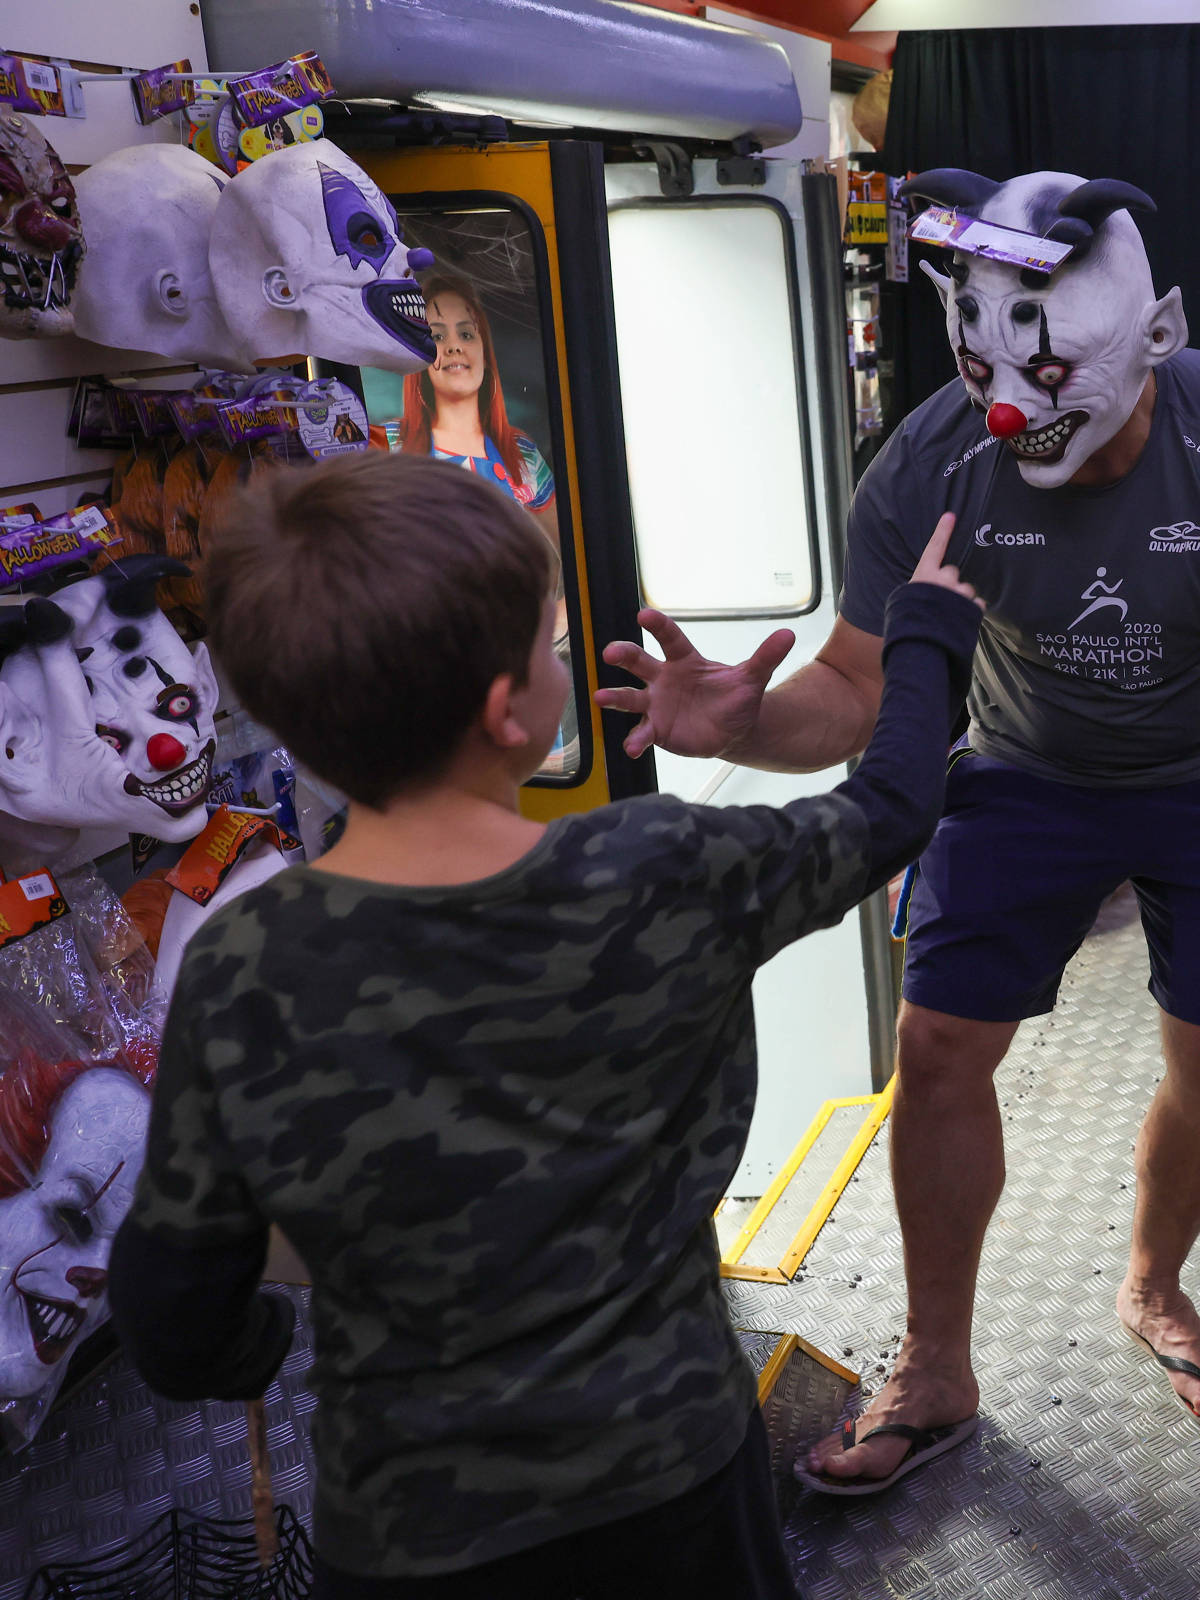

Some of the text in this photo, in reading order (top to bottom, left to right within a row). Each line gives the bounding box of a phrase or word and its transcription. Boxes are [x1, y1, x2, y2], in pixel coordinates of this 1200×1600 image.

[225, 404, 280, 435] HALLOWEEN
[994, 532, 1046, 546] cosan
[1124, 623, 1162, 634] 2020
[1072, 635, 1120, 647] PAULO
[1125, 636, 1162, 647] INT'L
[1040, 645, 1163, 664] MARATHON
[1054, 663, 1151, 680] 42K 21K 5K
[1139, 677, 1164, 688] PAULO
